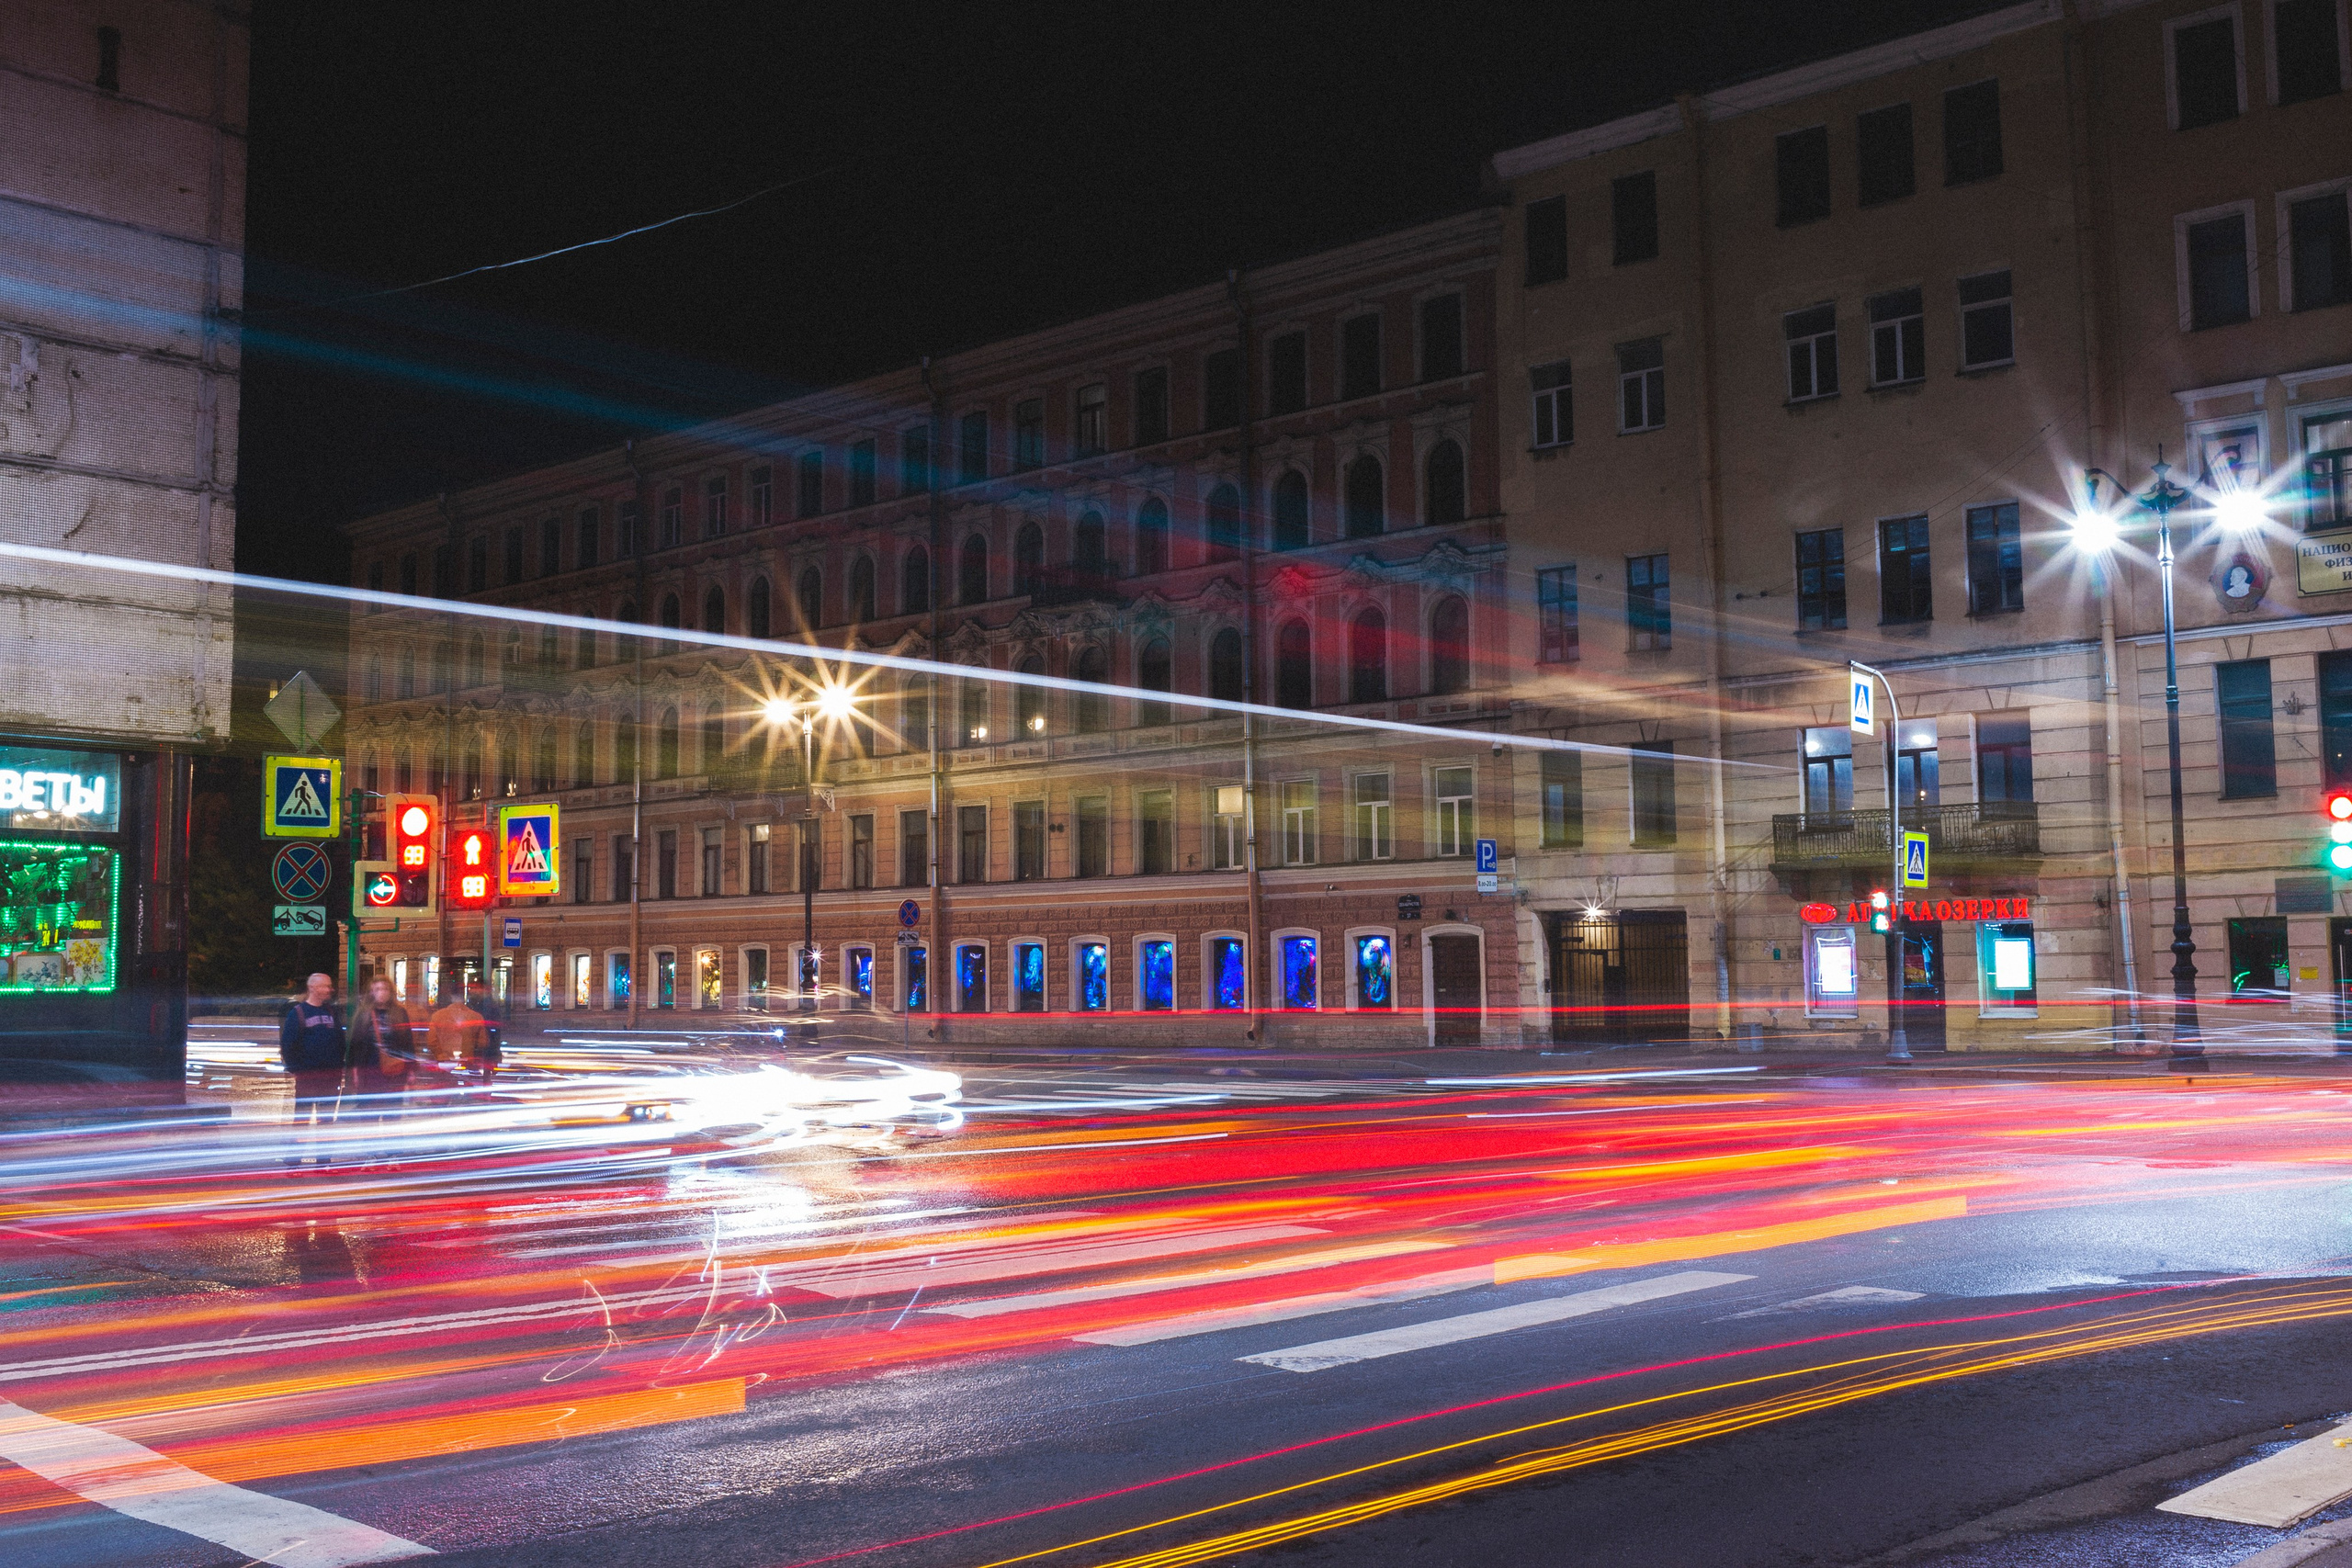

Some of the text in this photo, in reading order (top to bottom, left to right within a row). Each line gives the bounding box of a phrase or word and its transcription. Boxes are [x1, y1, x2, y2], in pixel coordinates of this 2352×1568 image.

[2302, 542, 2352, 557] НАЦИО
[0, 770, 106, 814] ВЕТЫ
[1482, 842, 1493, 869] P
[1846, 898, 2030, 923] АПКА ОЗЕРКИ
